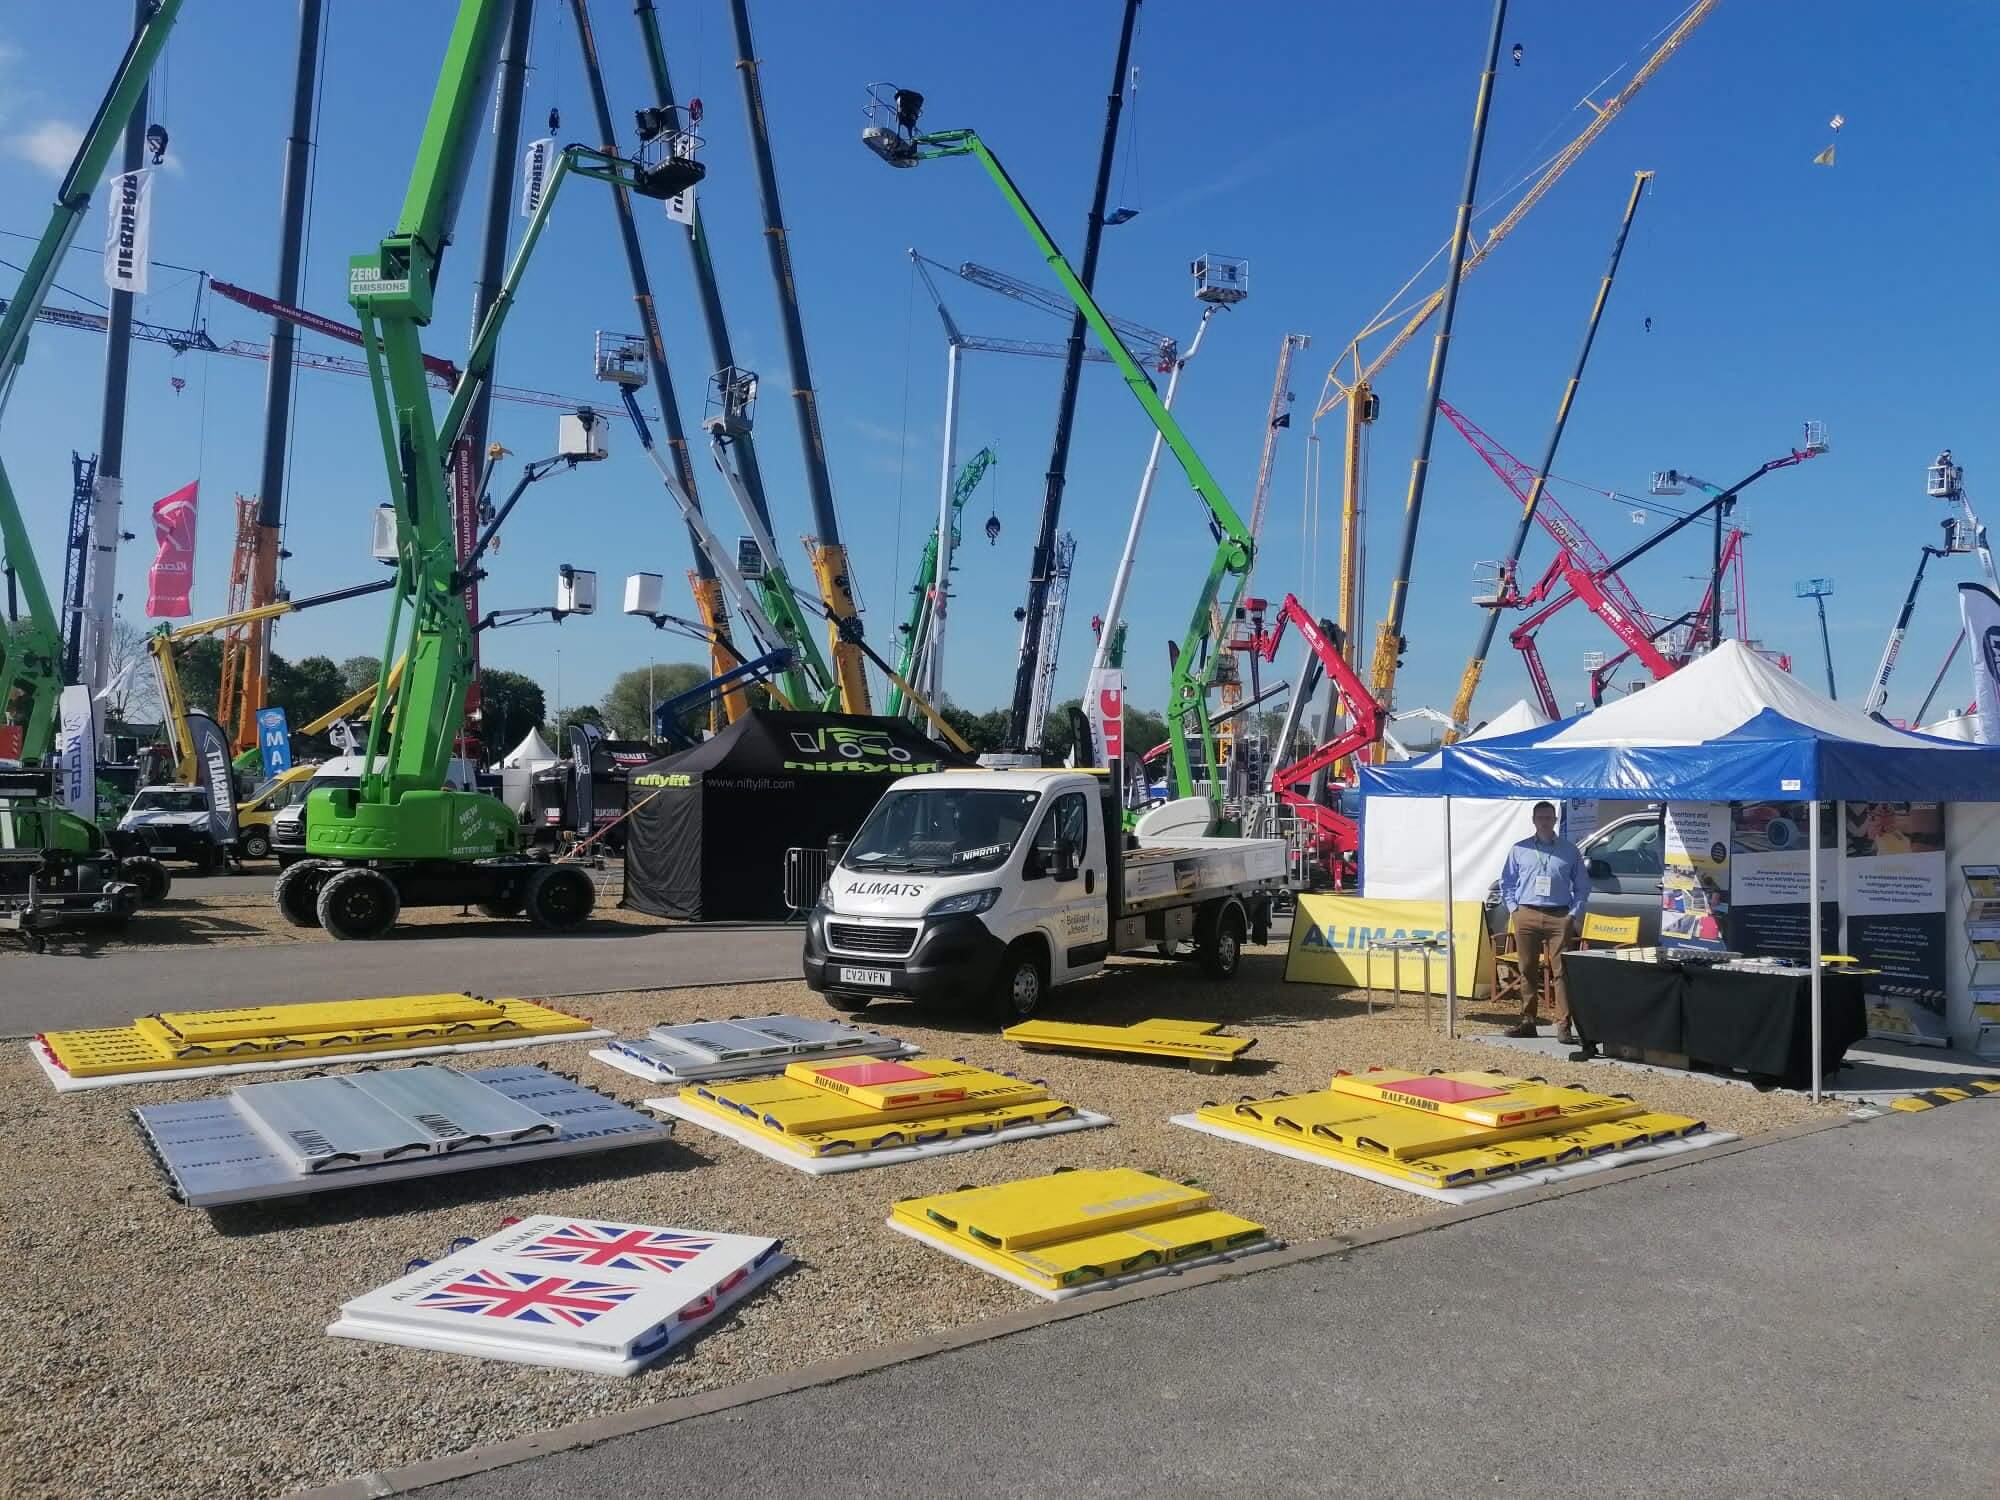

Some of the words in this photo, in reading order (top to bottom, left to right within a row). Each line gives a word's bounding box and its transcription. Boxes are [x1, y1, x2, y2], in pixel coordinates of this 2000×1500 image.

[351, 267, 381, 281] ZERO
[353, 282, 406, 292] EMISSIONS
[634, 774, 691, 788] niftylift
[706, 777, 795, 791] www.niftylift.com
[846, 881, 924, 897] ALIMATS
[845, 969, 866, 982] CV21
[868, 970, 886, 984] VFN
[1381, 1090, 1439, 1112] HALF-LOADER
[492, 1222, 555, 1253] ALIMATS
[391, 1267, 464, 1302] ALIMATS
